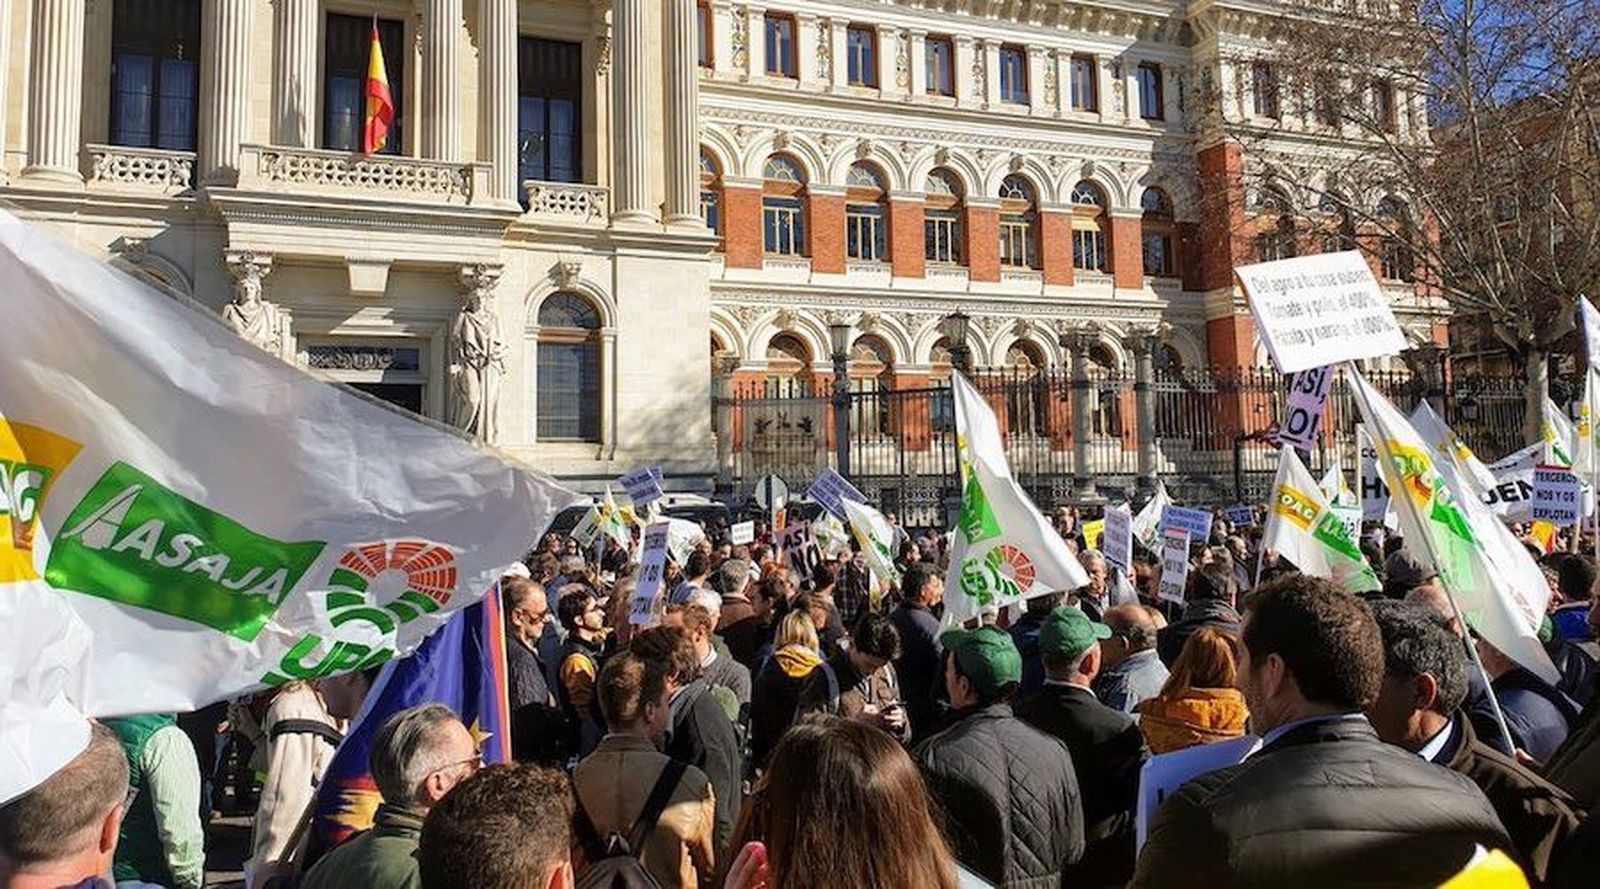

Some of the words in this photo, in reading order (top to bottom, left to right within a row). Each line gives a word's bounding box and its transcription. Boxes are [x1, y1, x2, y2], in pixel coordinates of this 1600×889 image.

[1536, 471, 1577, 484] TERCEROS
[1537, 489, 1553, 501] NOS
[1555, 490, 1562, 501] Y
[1563, 491, 1575, 502] OS
[1533, 507, 1577, 520] EXPLOTAN
